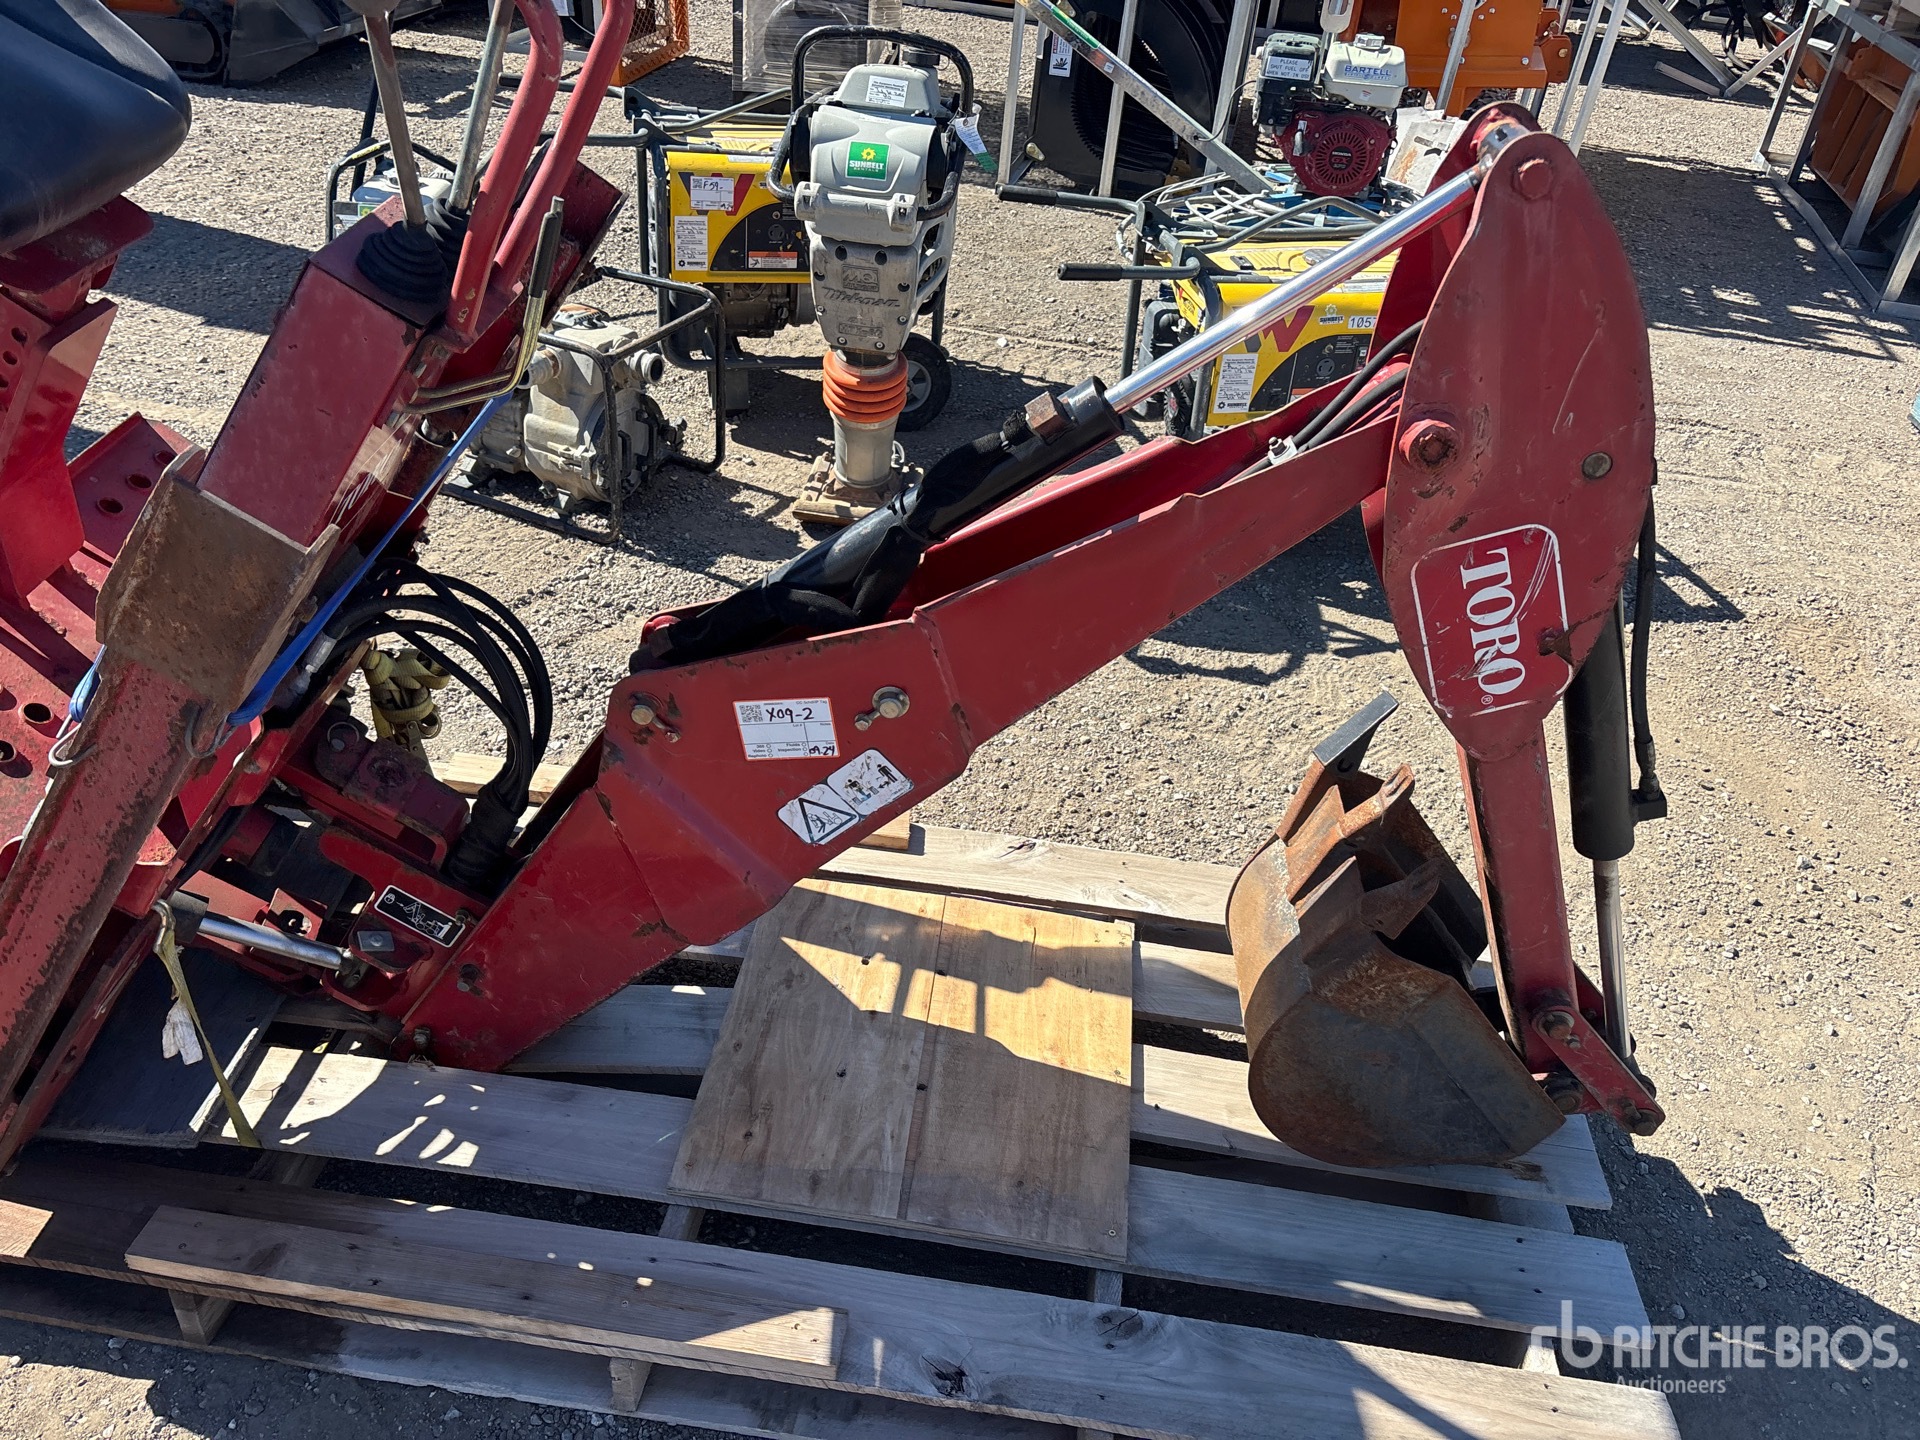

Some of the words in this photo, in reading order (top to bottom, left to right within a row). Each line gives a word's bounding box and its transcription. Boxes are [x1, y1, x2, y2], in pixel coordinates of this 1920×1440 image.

[1345, 65, 1391, 76] BARTELL
[849, 160, 884, 170] SUNBELT
[1460, 547, 1526, 695] TORO
[766, 707, 814, 723] X09-2
